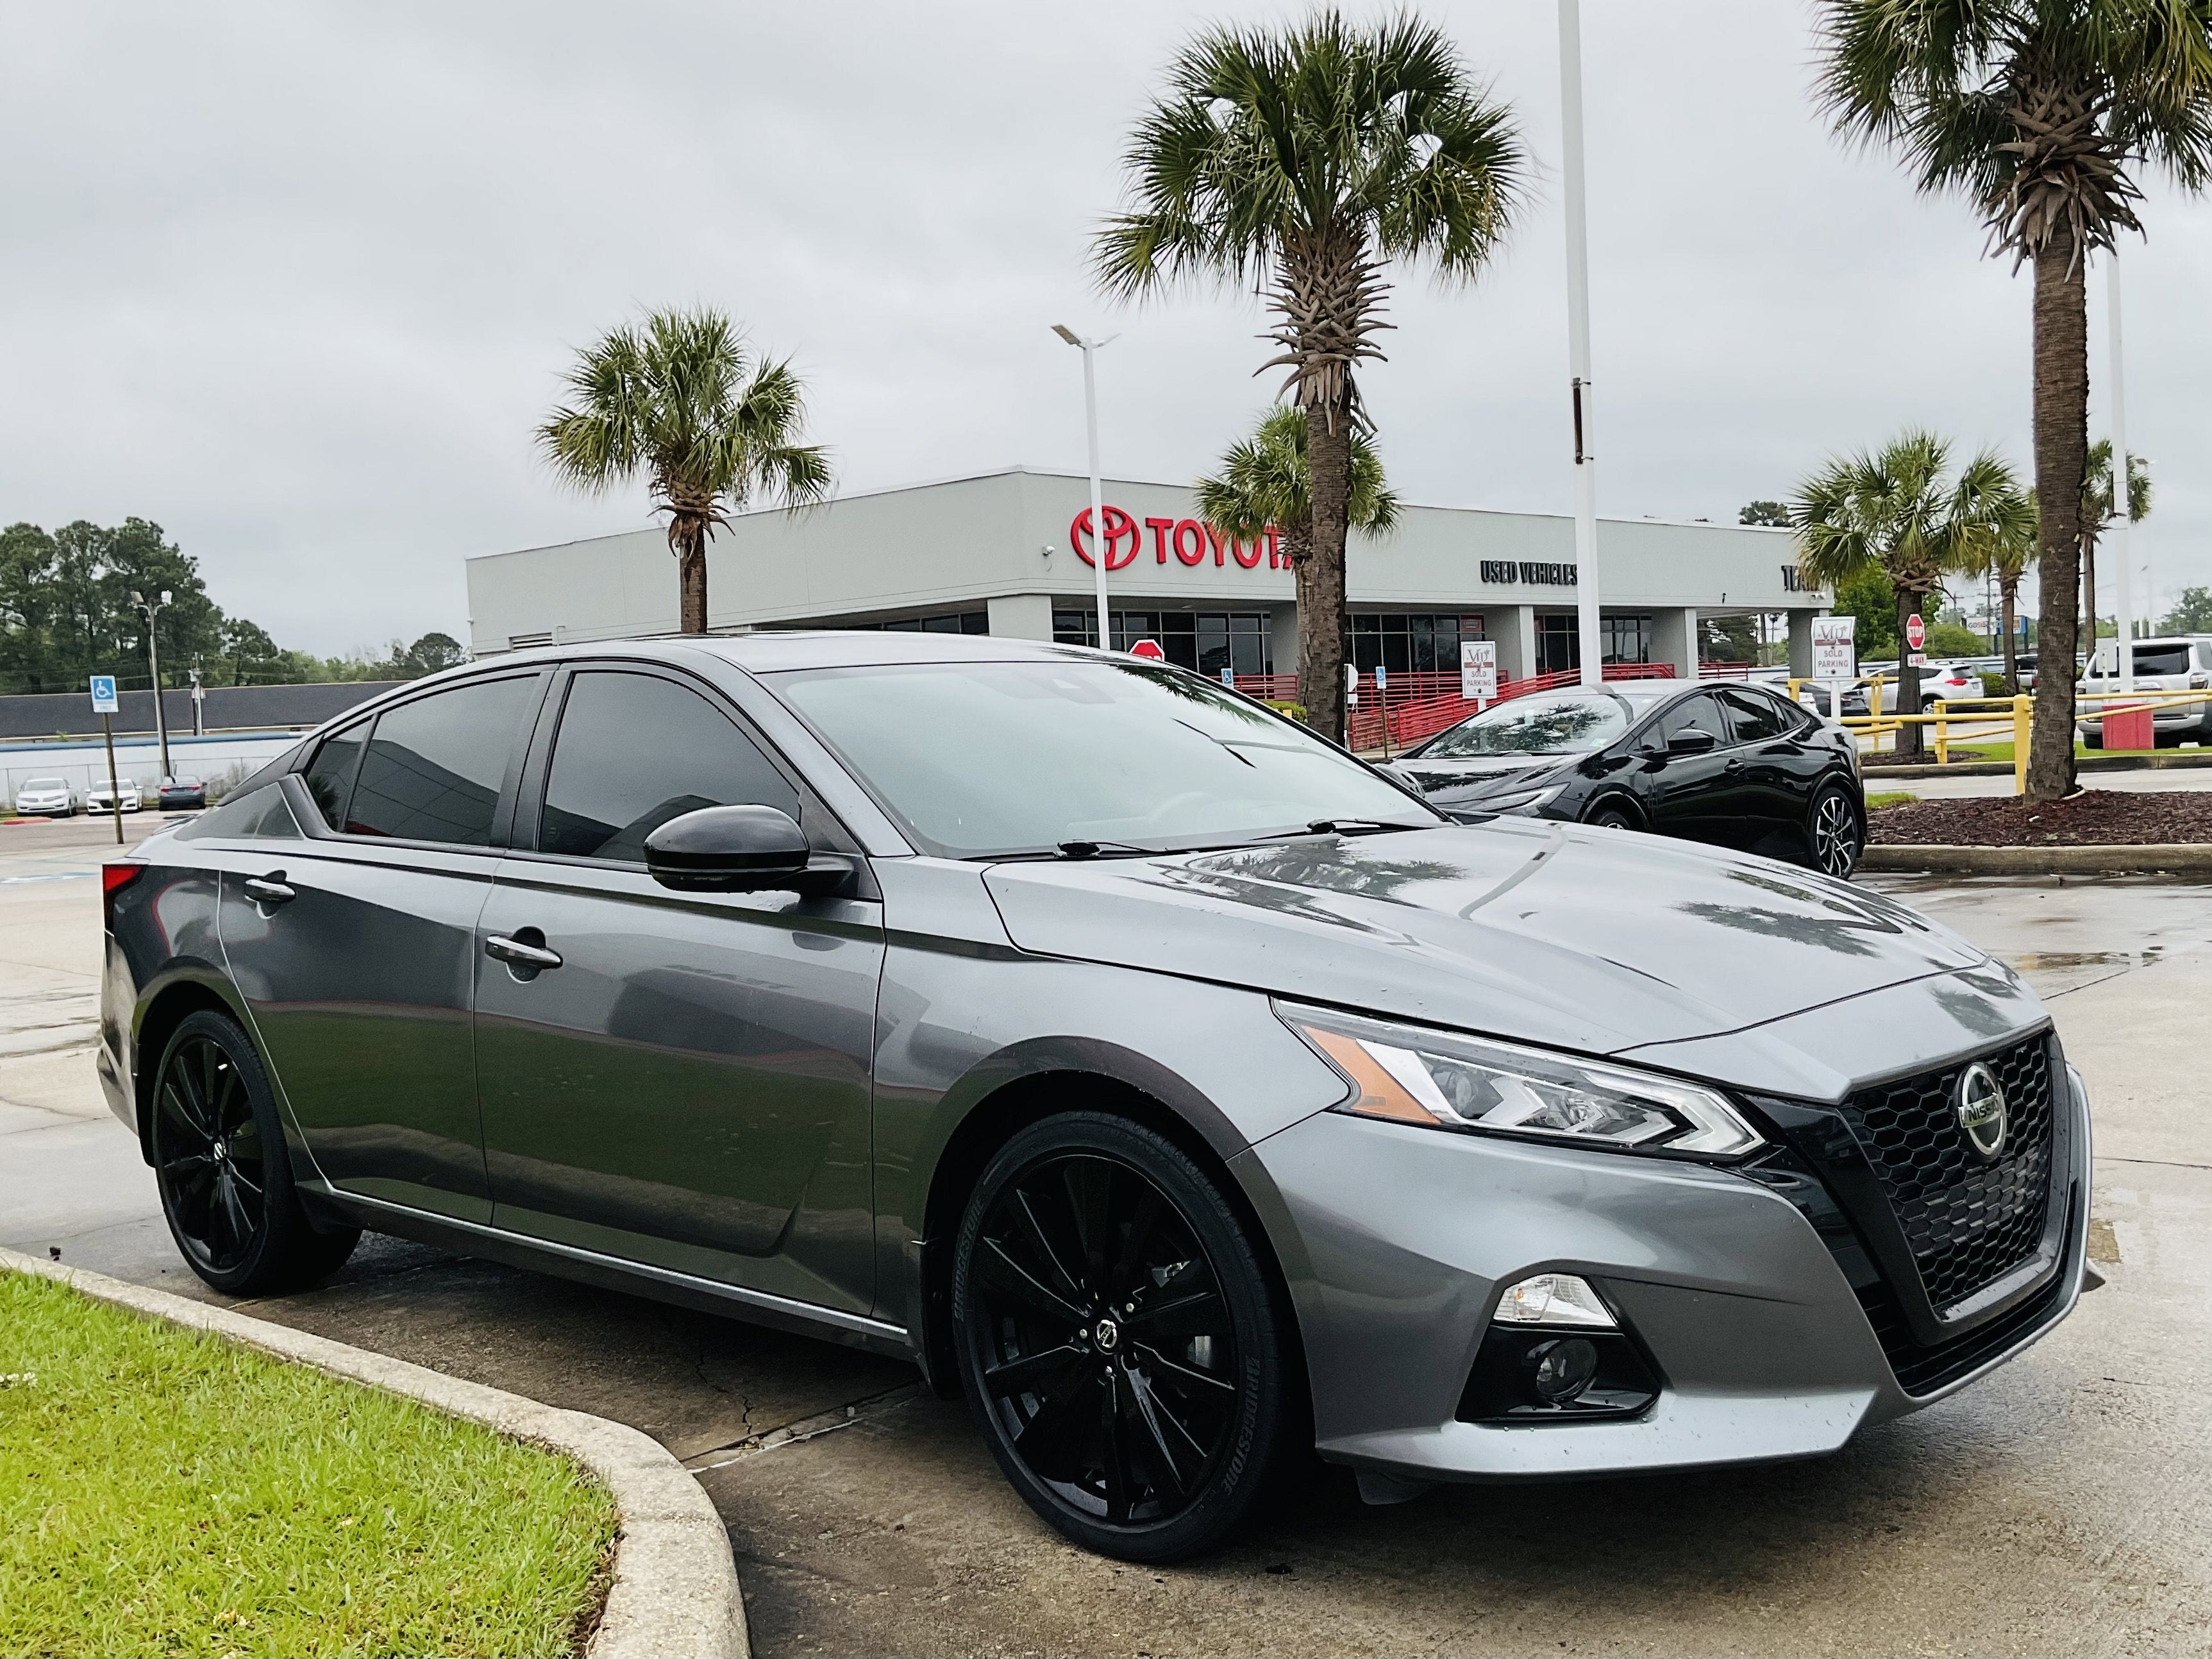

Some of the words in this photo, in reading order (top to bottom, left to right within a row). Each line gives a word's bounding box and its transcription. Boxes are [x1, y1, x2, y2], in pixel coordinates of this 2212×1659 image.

[1145, 518, 1293, 569] TOYOT
[1480, 560, 1518, 583] USED
[1519, 562, 1577, 585] VEHICLES
[1908, 626, 1923, 637] STOP
[1909, 656, 1924, 664] 4-WAY
[1221, 1354, 1261, 1495] BRIDGESTONE
